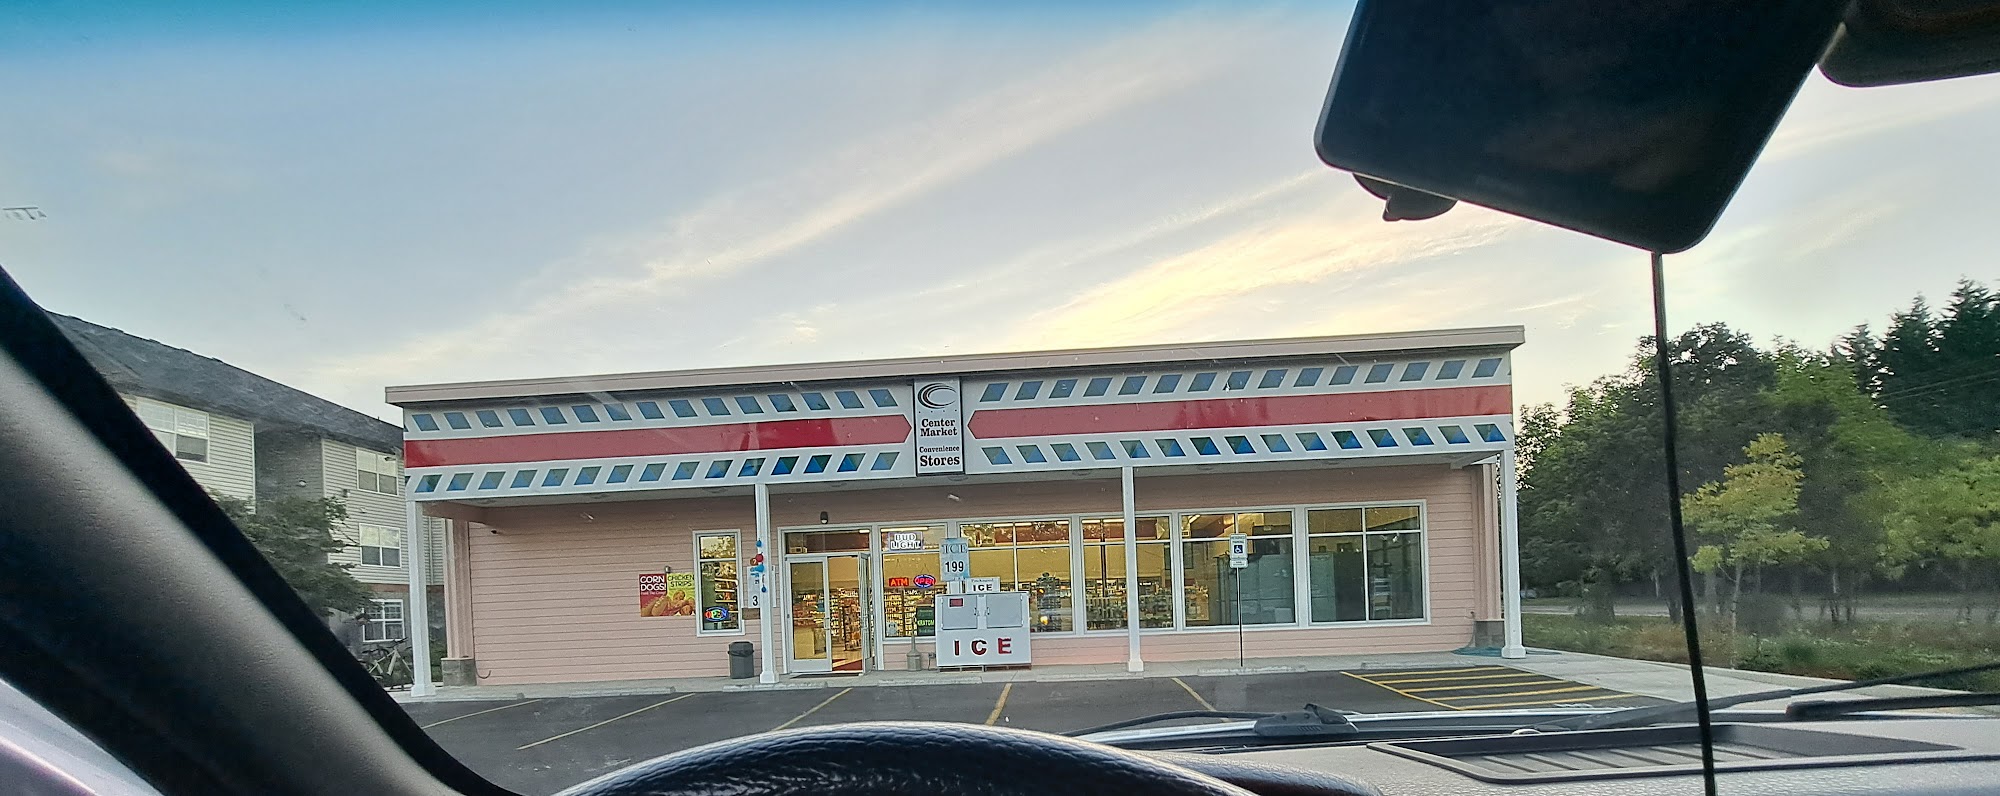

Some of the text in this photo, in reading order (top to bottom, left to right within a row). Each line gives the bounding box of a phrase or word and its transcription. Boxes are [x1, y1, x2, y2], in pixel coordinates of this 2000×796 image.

[921, 418, 955, 427] Center
[920, 427, 957, 437] Market
[919, 445, 960, 453] Convenience
[920, 455, 960, 467] Stores
[894, 533, 917, 541] BUD
[890, 541, 921, 550] LIGHT
[942, 543, 968, 554] ICE
[945, 561, 964, 573] 199
[640, 575, 665, 584] CORN
[890, 578, 908, 586] ATM
[915, 577, 935, 585] OPEN
[640, 583, 667, 591] DOGS!
[973, 584, 993, 592] ICE
[704, 611, 728, 619] OPEN
[953, 637, 1012, 656] ICE
